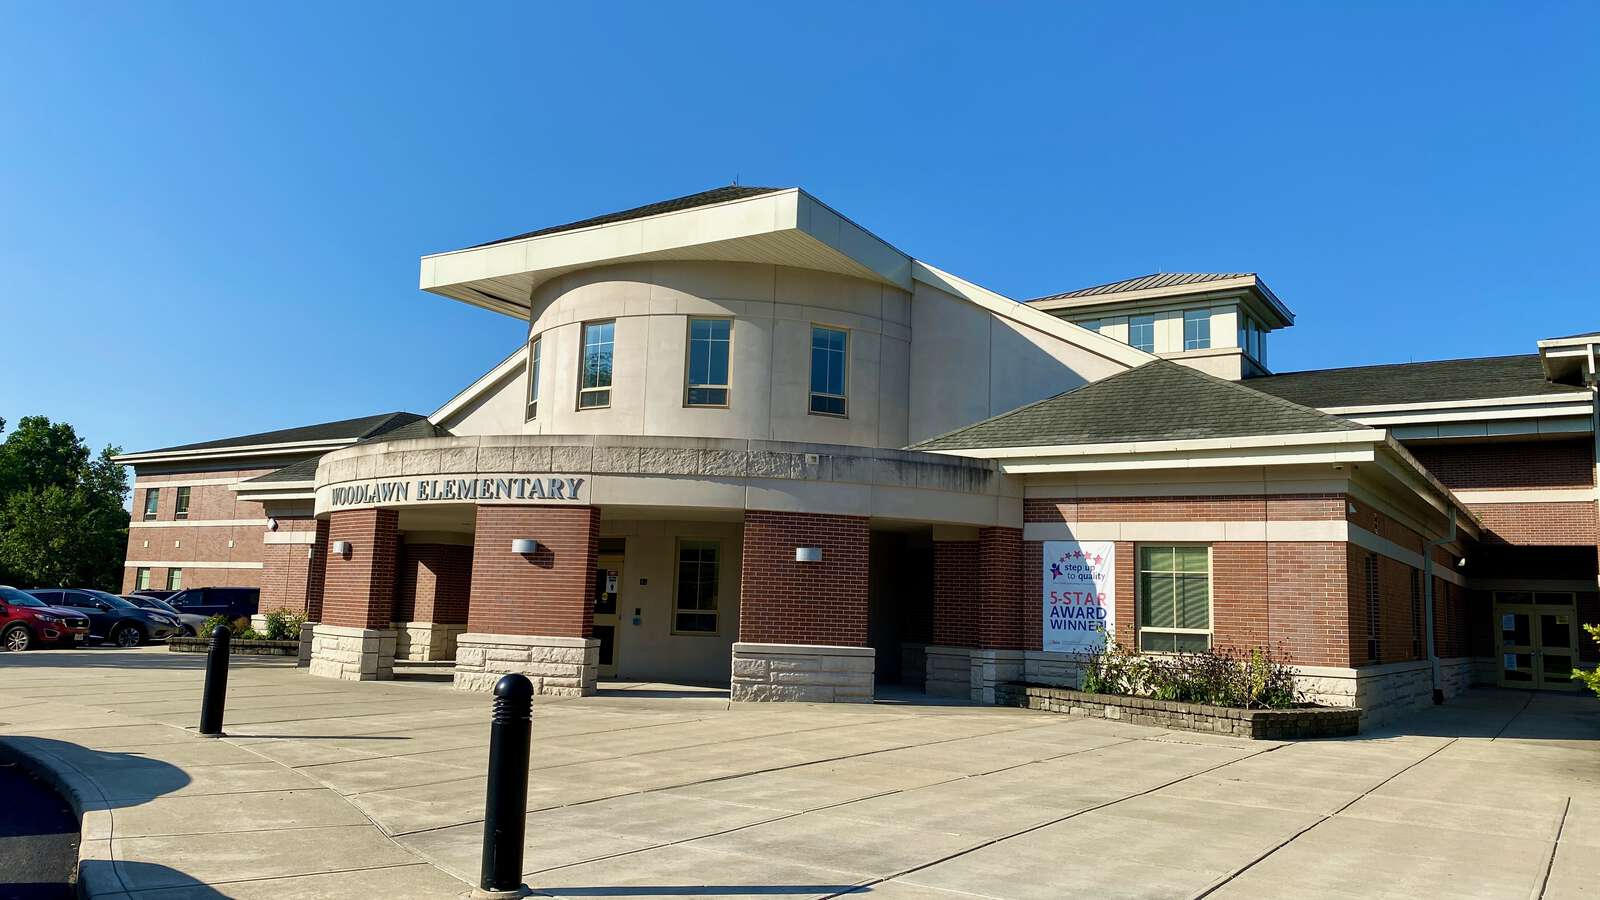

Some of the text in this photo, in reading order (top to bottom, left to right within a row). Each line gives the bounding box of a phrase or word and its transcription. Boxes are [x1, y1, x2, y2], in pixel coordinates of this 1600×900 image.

[331, 477, 585, 506] WOODLAWN ELEMENTARY
[1064, 563, 1096, 573] step up
[1078, 571, 1106, 581] quality
[1050, 591, 1107, 606] 5-STAR
[1050, 606, 1107, 620] AWARD
